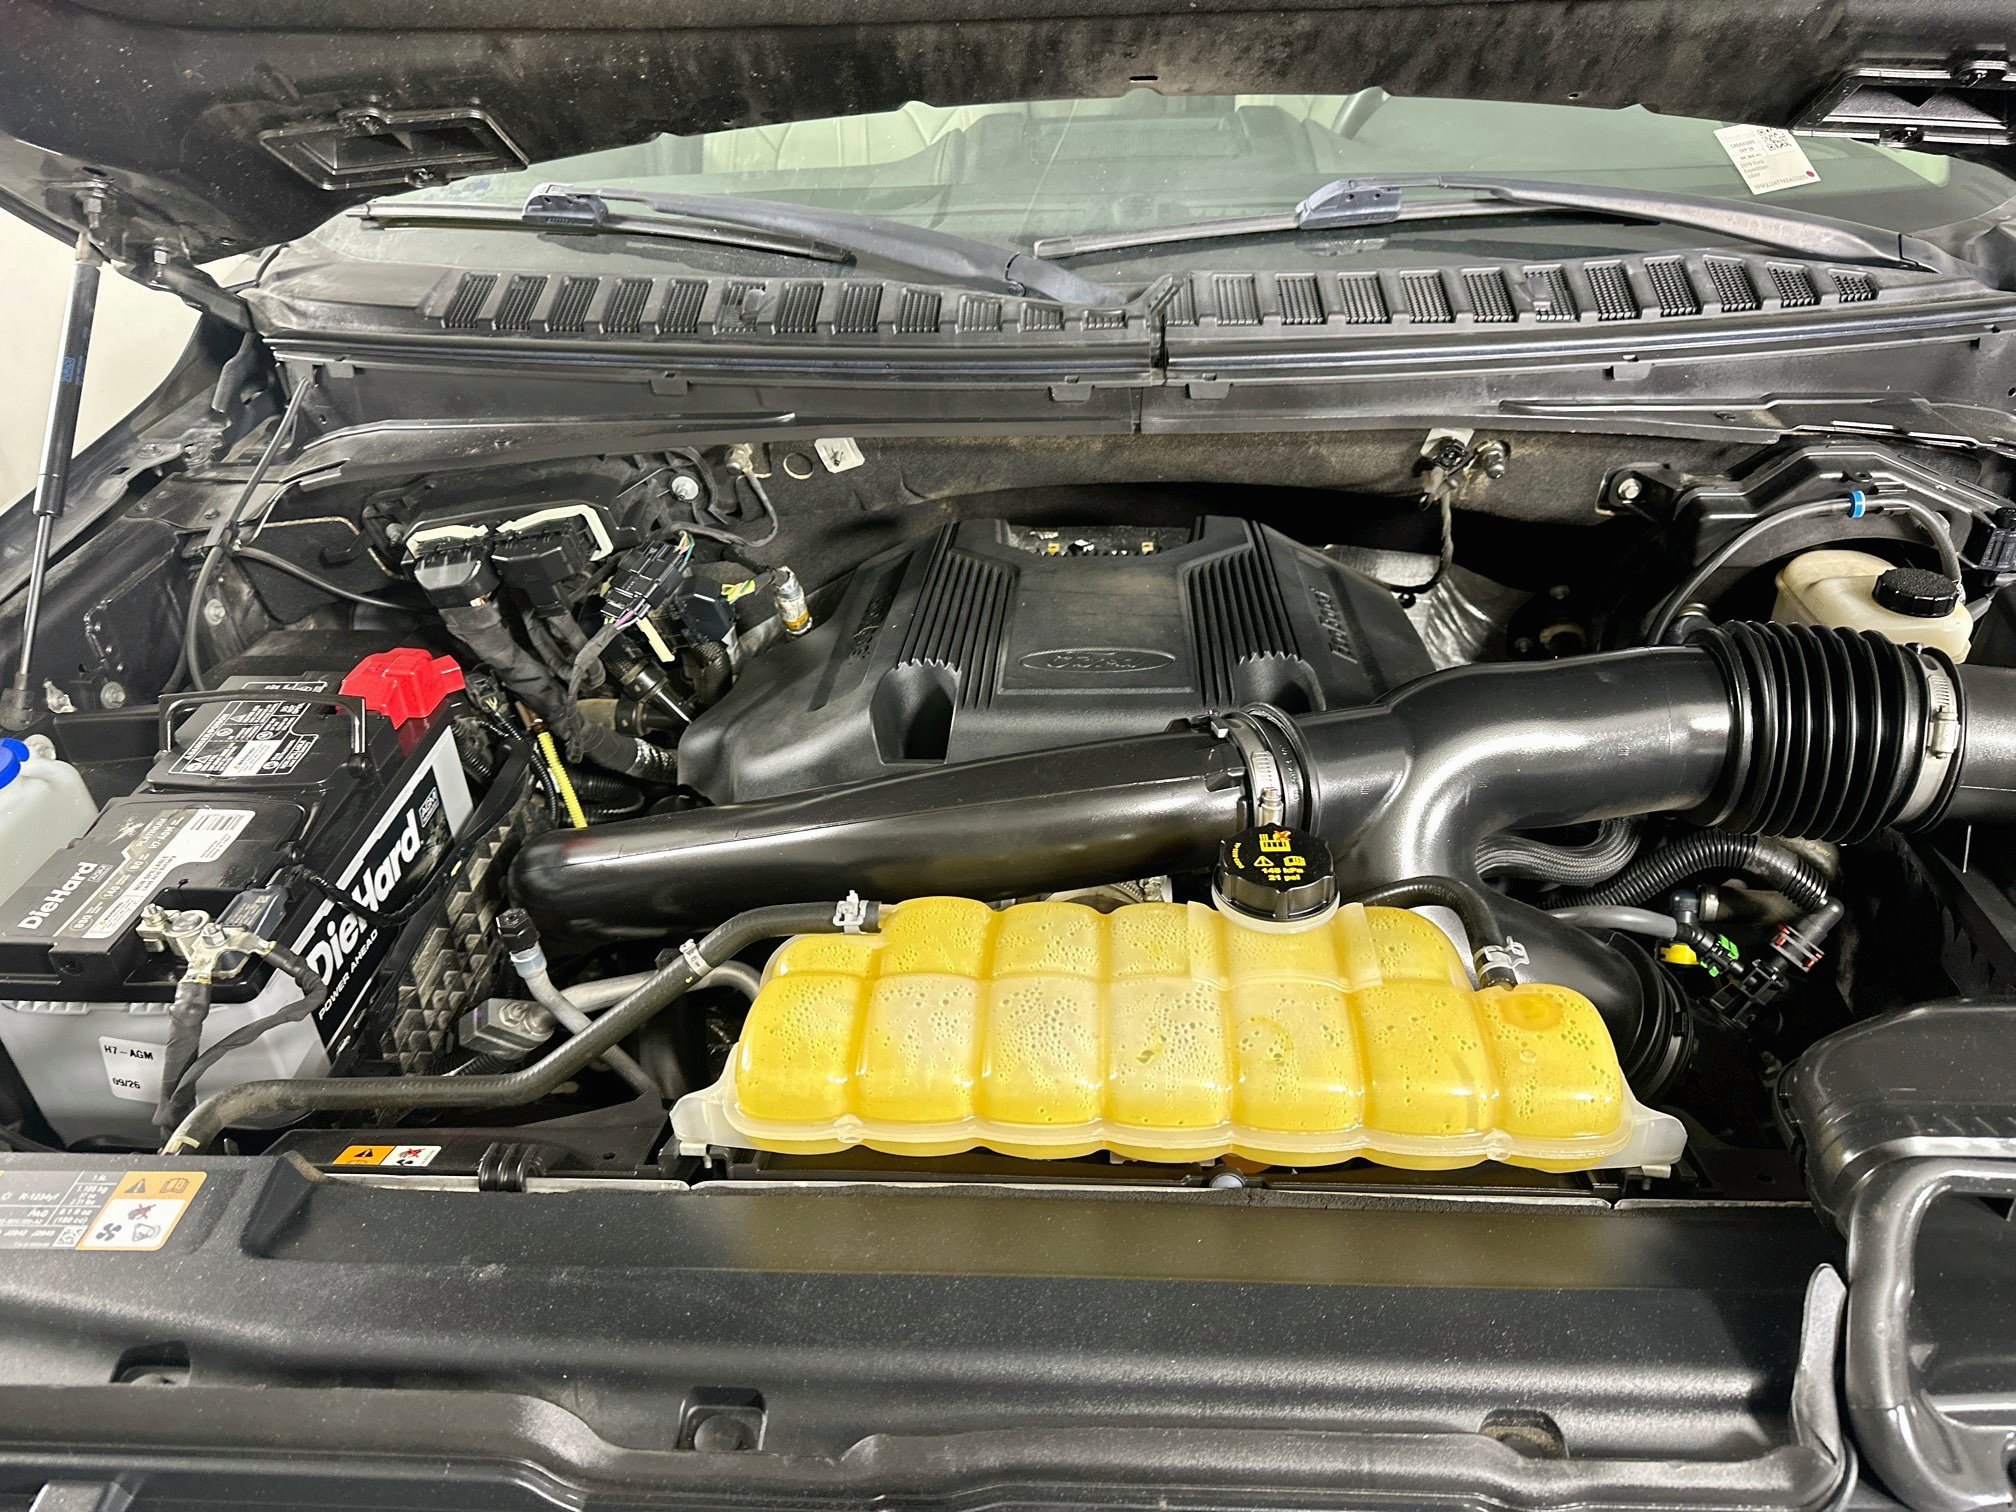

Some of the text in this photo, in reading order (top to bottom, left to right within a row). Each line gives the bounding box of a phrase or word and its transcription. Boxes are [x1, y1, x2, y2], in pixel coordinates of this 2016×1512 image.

[137, 818, 168, 847] PLATINUM
[17, 861, 98, 929] DieHard
[306, 808, 421, 985] DieHard
[318, 929, 378, 1020] POWER AHEAD
[112, 1078, 141, 1089] 09/26
